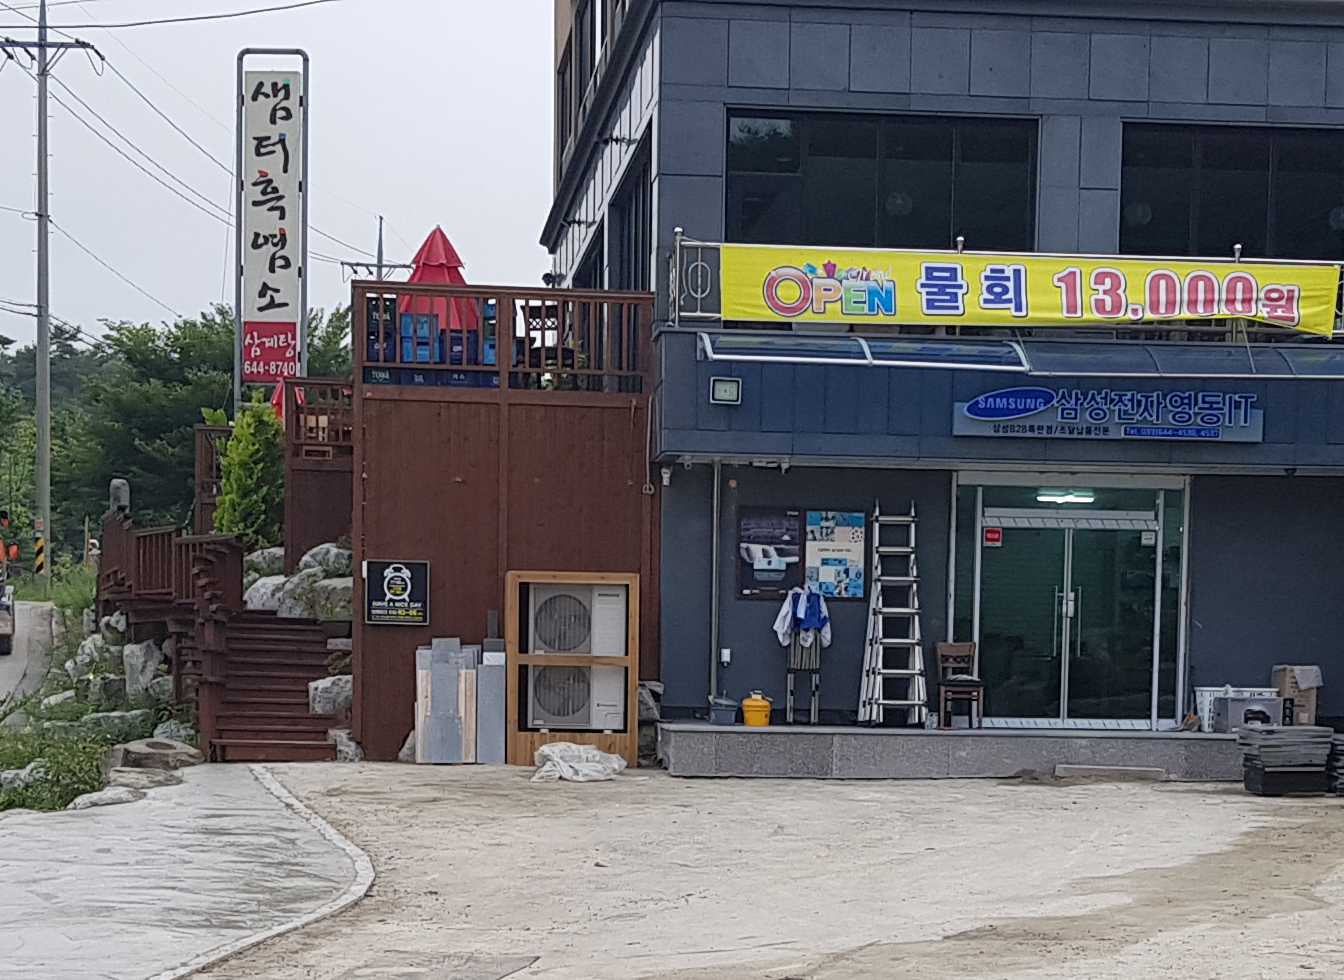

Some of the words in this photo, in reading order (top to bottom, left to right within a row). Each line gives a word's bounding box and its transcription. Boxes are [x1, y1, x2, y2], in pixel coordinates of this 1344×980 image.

[762, 265, 897, 318] OPEN
[244, 331, 296, 359] 삼계탕
[244, 360, 296, 375] 644-8740
[977, 397, 1046, 410] SAMSUNG
